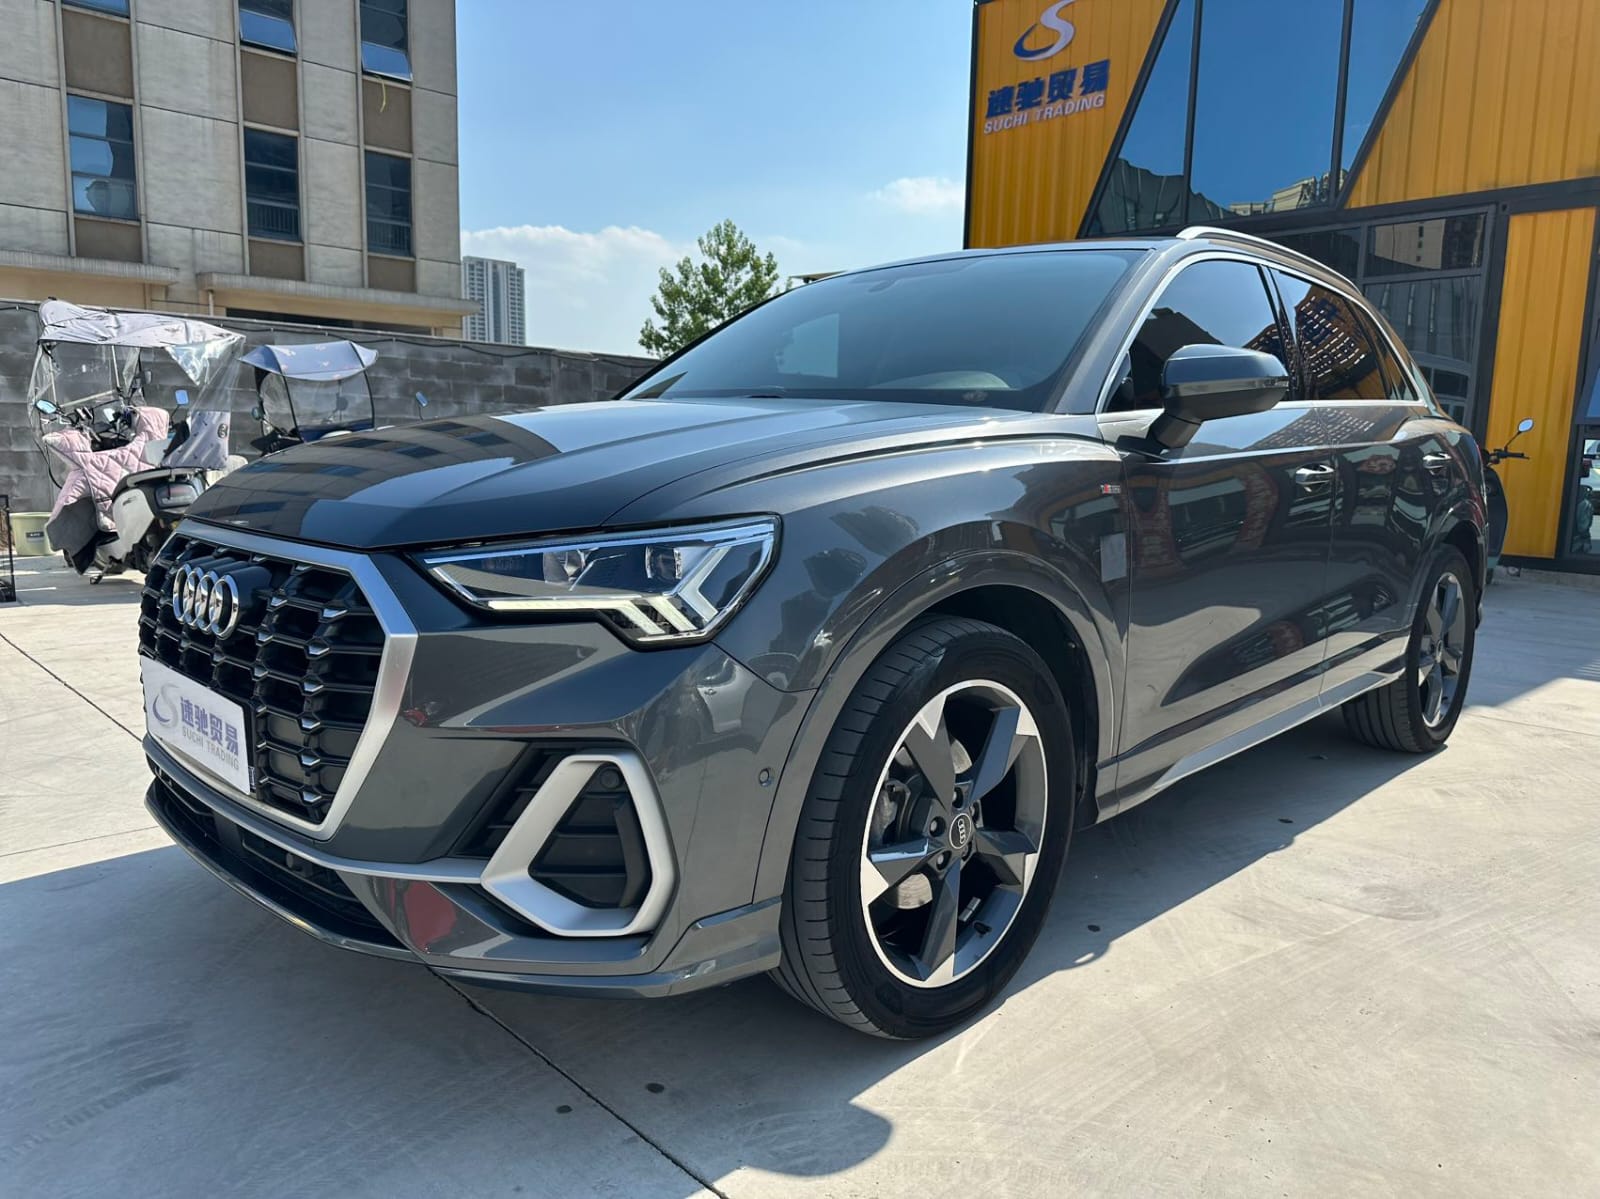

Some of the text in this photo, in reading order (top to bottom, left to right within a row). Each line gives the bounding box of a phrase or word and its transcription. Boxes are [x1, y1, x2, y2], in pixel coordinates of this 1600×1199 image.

[986, 59, 1110, 118] 速驰贸易
[984, 94, 1105, 134] SUCHI TRADING
[180, 696, 239, 756] 速驰贸易
[206, 740, 239, 770] TRADING
